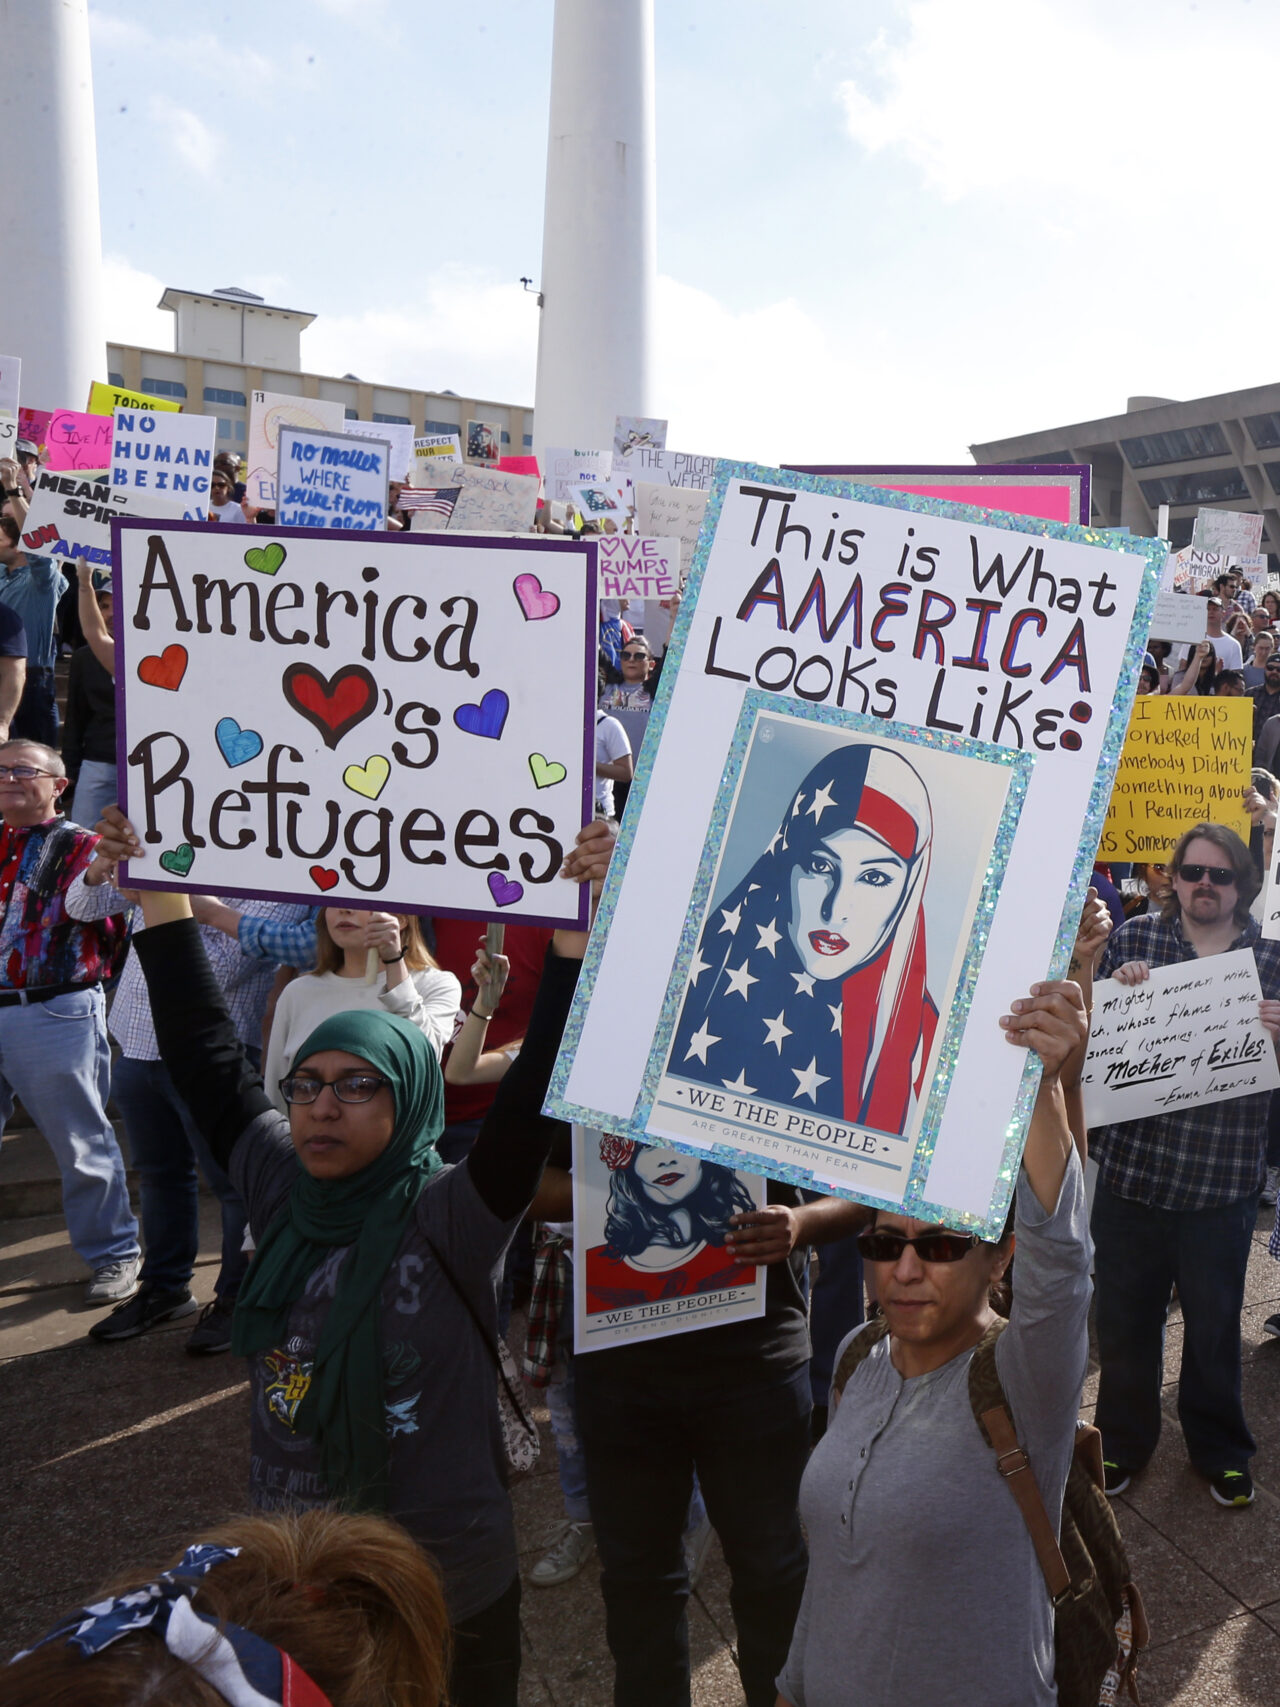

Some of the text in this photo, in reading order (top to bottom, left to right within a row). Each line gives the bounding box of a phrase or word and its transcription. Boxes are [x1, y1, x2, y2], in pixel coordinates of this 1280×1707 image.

[117, 414, 156, 433] NO
[114, 440, 210, 467] HUMAN
[414, 437, 452, 448] RESPECT
[637, 449, 666, 469] THE
[112, 468, 209, 493] BEING
[300, 466, 351, 491] WHERE
[580, 472, 596, 481] not
[22, 524, 60, 550] UN
[739, 485, 866, 566] This
[898, 528, 940, 582] is
[969, 535, 1116, 616] What
[604, 576, 677, 596] HATE
[132, 534, 480, 678] America
[736, 558, 1092, 692] AMERICA
[1136, 701, 1152, 720] I
[1211, 732, 1247, 756] Why
[1193, 756, 1244, 775] Didn't
[1210, 785, 1246, 800] about
[128, 731, 564, 892] Refugees
[1126, 829, 1182, 854] Somebo
[1162, 976, 1214, 996] woman
[1224, 968, 1252, 982] with
[1117, 1015, 1156, 1032] whose
[1165, 1002, 1212, 1026] flame
[1220, 998, 1232, 1008] is
[1237, 992, 1258, 1004] the
[1204, 1020, 1229, 1034] and
[1104, 1052, 1186, 1085] Mother
[1190, 1054, 1204, 1076] of
[1205, 1075, 1258, 1096] Lazarus
[688, 1087, 878, 1154] WE THE PEOPLE
[691, 1120, 859, 1172] ARE GREATER THAN FEAR
[606, 1290, 738, 1324] WE THE PEOPLE
